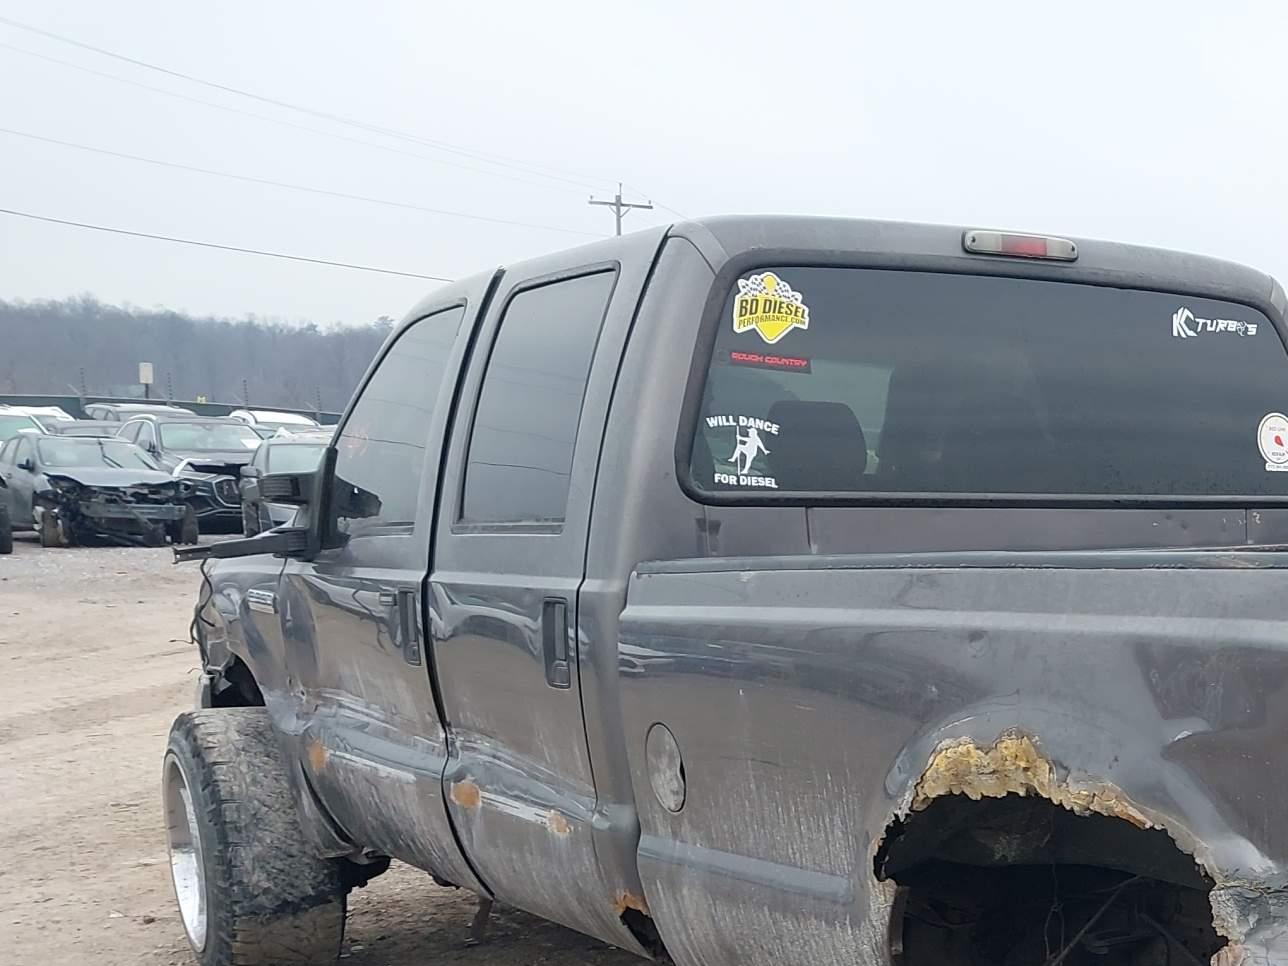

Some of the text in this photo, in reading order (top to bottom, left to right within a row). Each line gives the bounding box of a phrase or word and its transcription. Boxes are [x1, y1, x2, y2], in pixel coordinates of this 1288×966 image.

[738, 298, 807, 319] BD DIESEL
[1172, 306, 1198, 338] KC
[731, 352, 808, 367] ROUGH COUNTRY
[706, 415, 780, 435] WILL DANCE
[714, 473, 779, 489] FOR DIESEL
